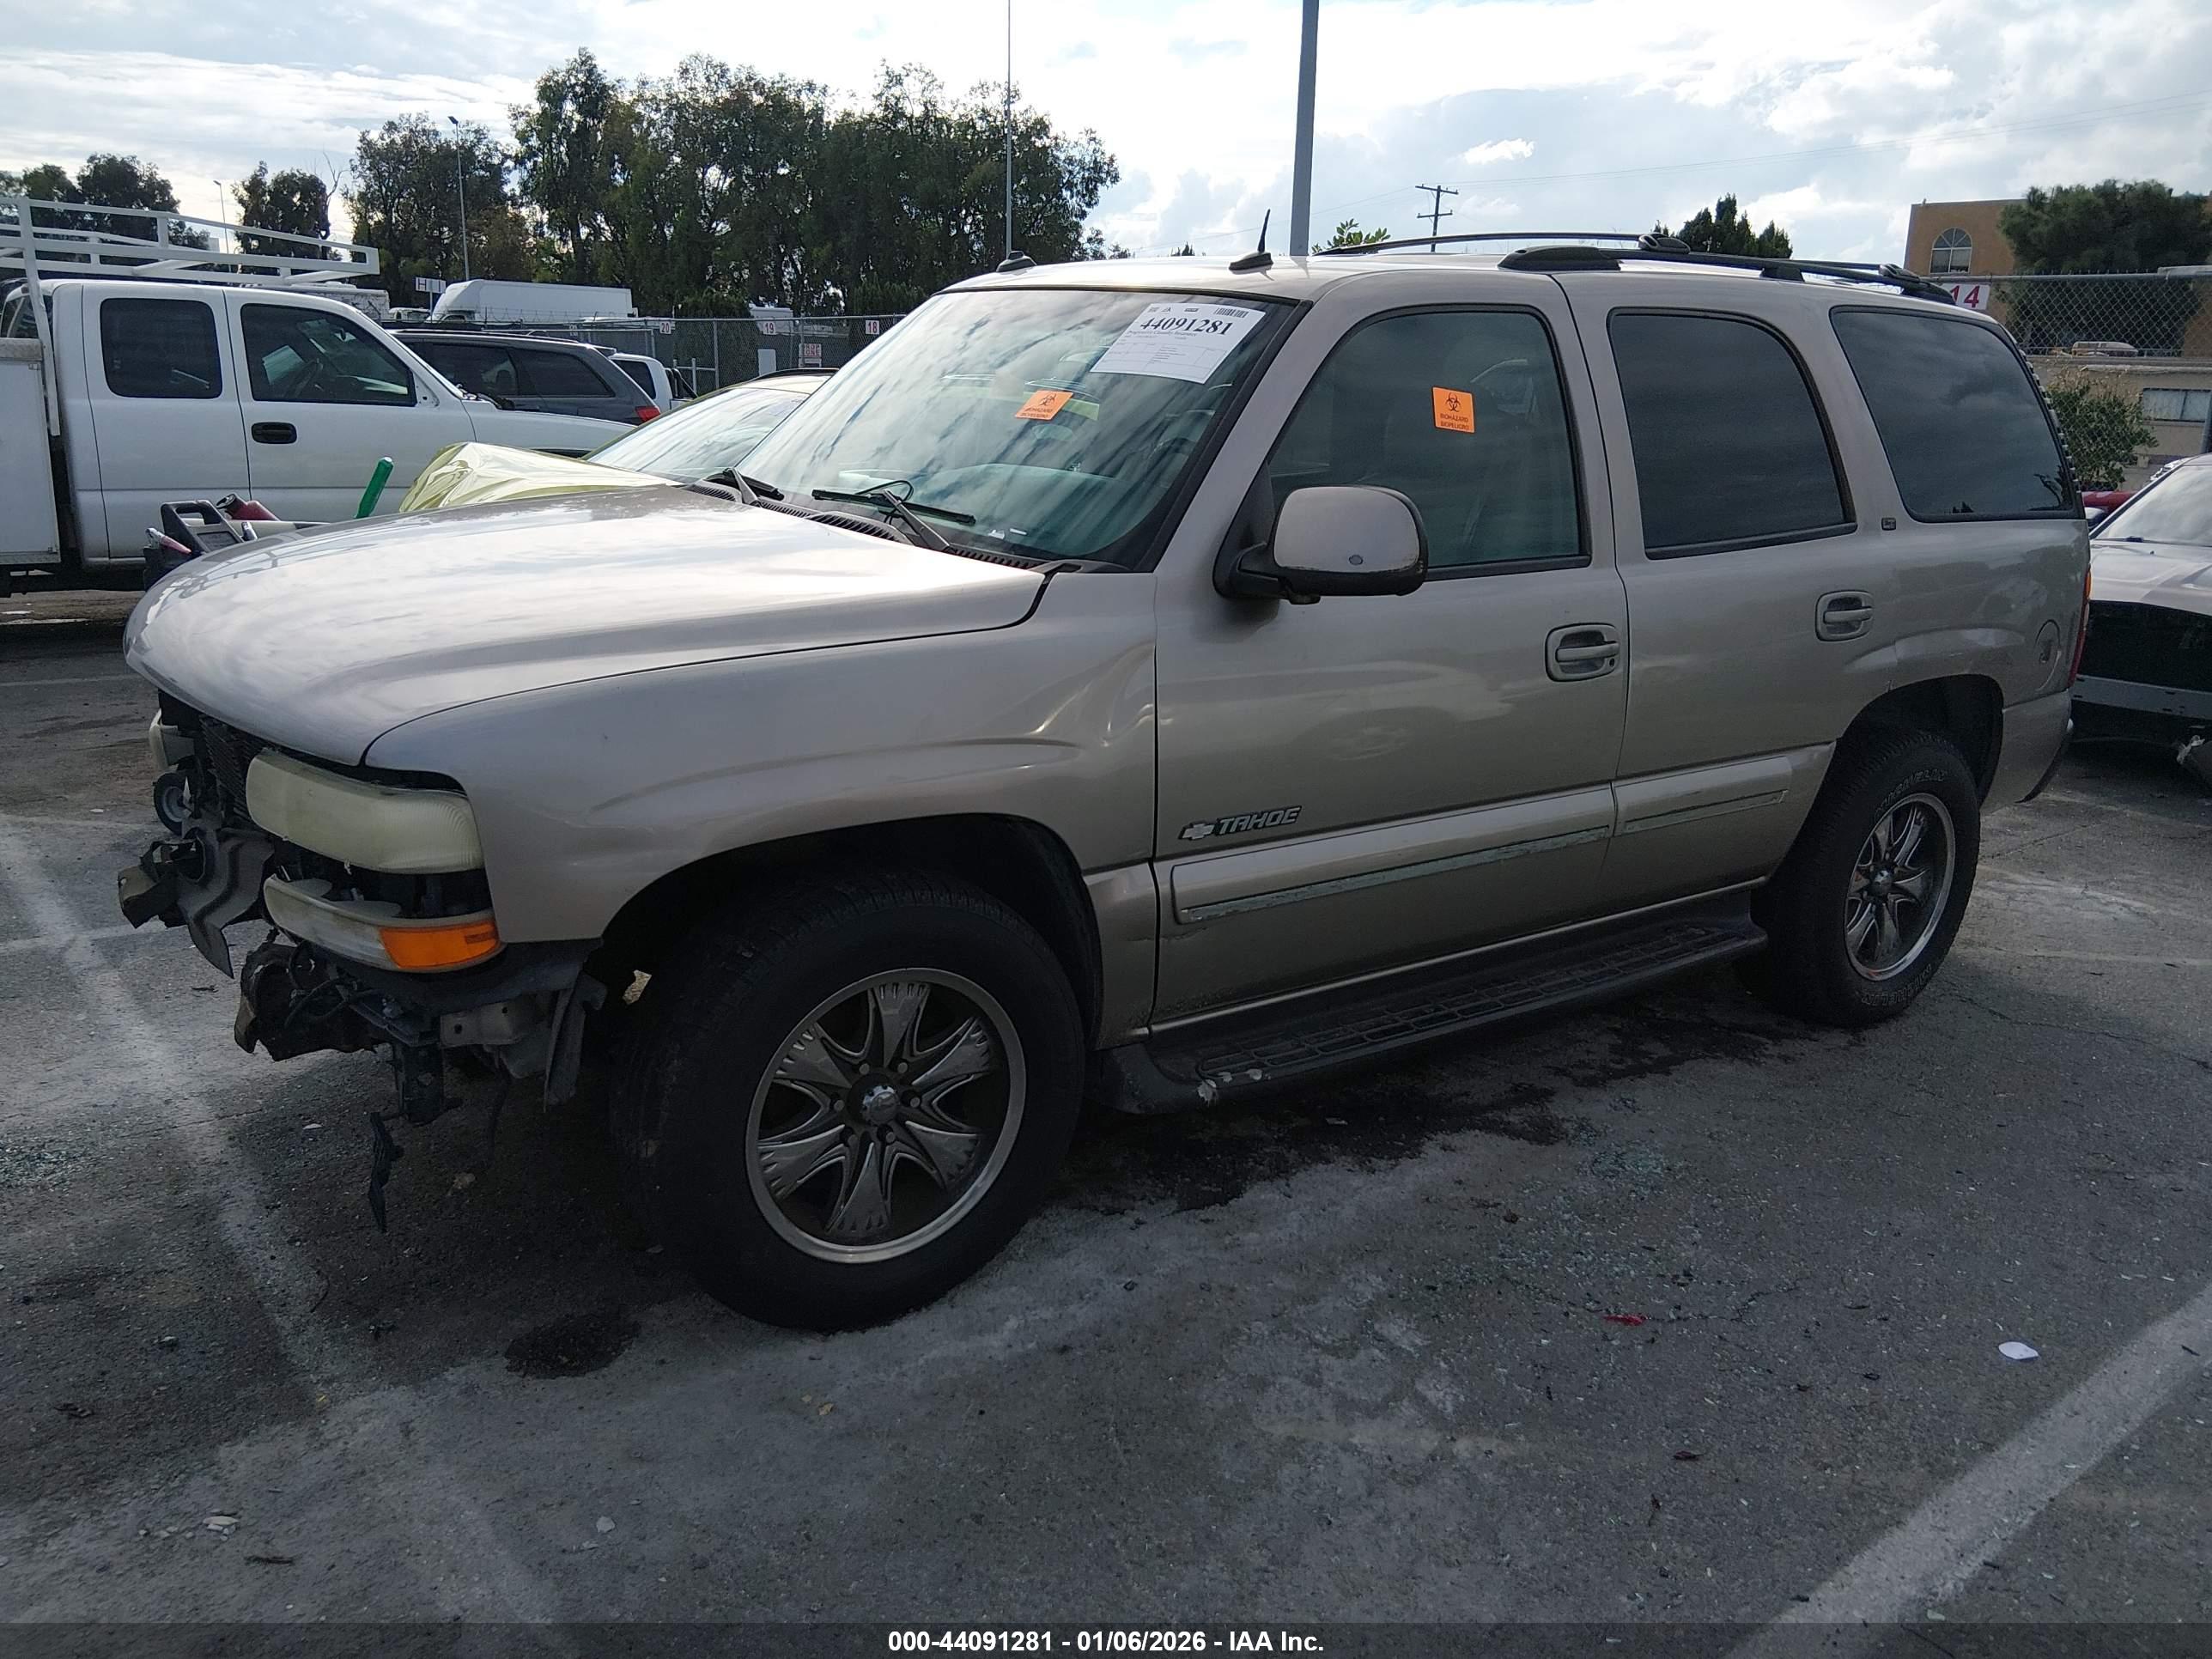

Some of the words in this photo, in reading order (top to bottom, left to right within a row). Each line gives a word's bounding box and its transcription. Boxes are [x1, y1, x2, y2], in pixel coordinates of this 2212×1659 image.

[1949, 284, 1980, 308] 14
[661, 322, 670, 333] 20
[765, 322, 775, 333] 19
[867, 320, 878, 333] 18
[1140, 317, 1234, 335] 44091281
[1440, 412, 1469, 422] BIOHAZARD
[1217, 805, 1302, 836] TAHOE
